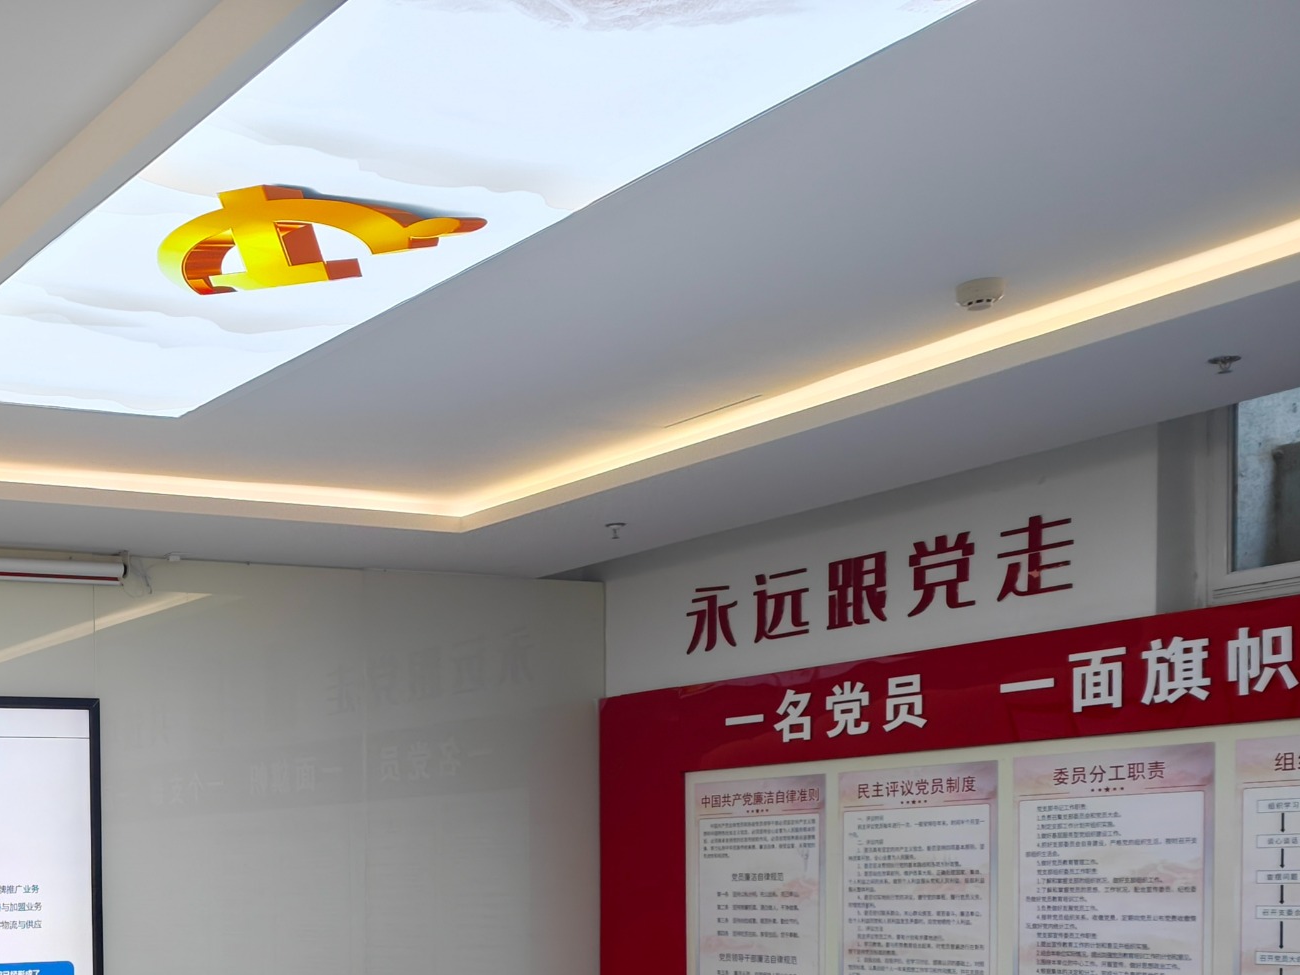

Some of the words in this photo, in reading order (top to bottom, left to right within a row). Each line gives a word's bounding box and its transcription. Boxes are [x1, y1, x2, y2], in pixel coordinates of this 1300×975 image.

[685, 514, 1075, 656] 永远跟党走
[725, 673, 929, 744] 一名党员
[1000, 625, 1300, 714] 一面旗帜
[1274, 752, 1300, 771] 组
[1053, 762, 1166, 785] 委员分工职责
[701, 788, 820, 808] 中国共产党廉洁自律准则
[857, 776, 976, 799] 民主评议党员制度
